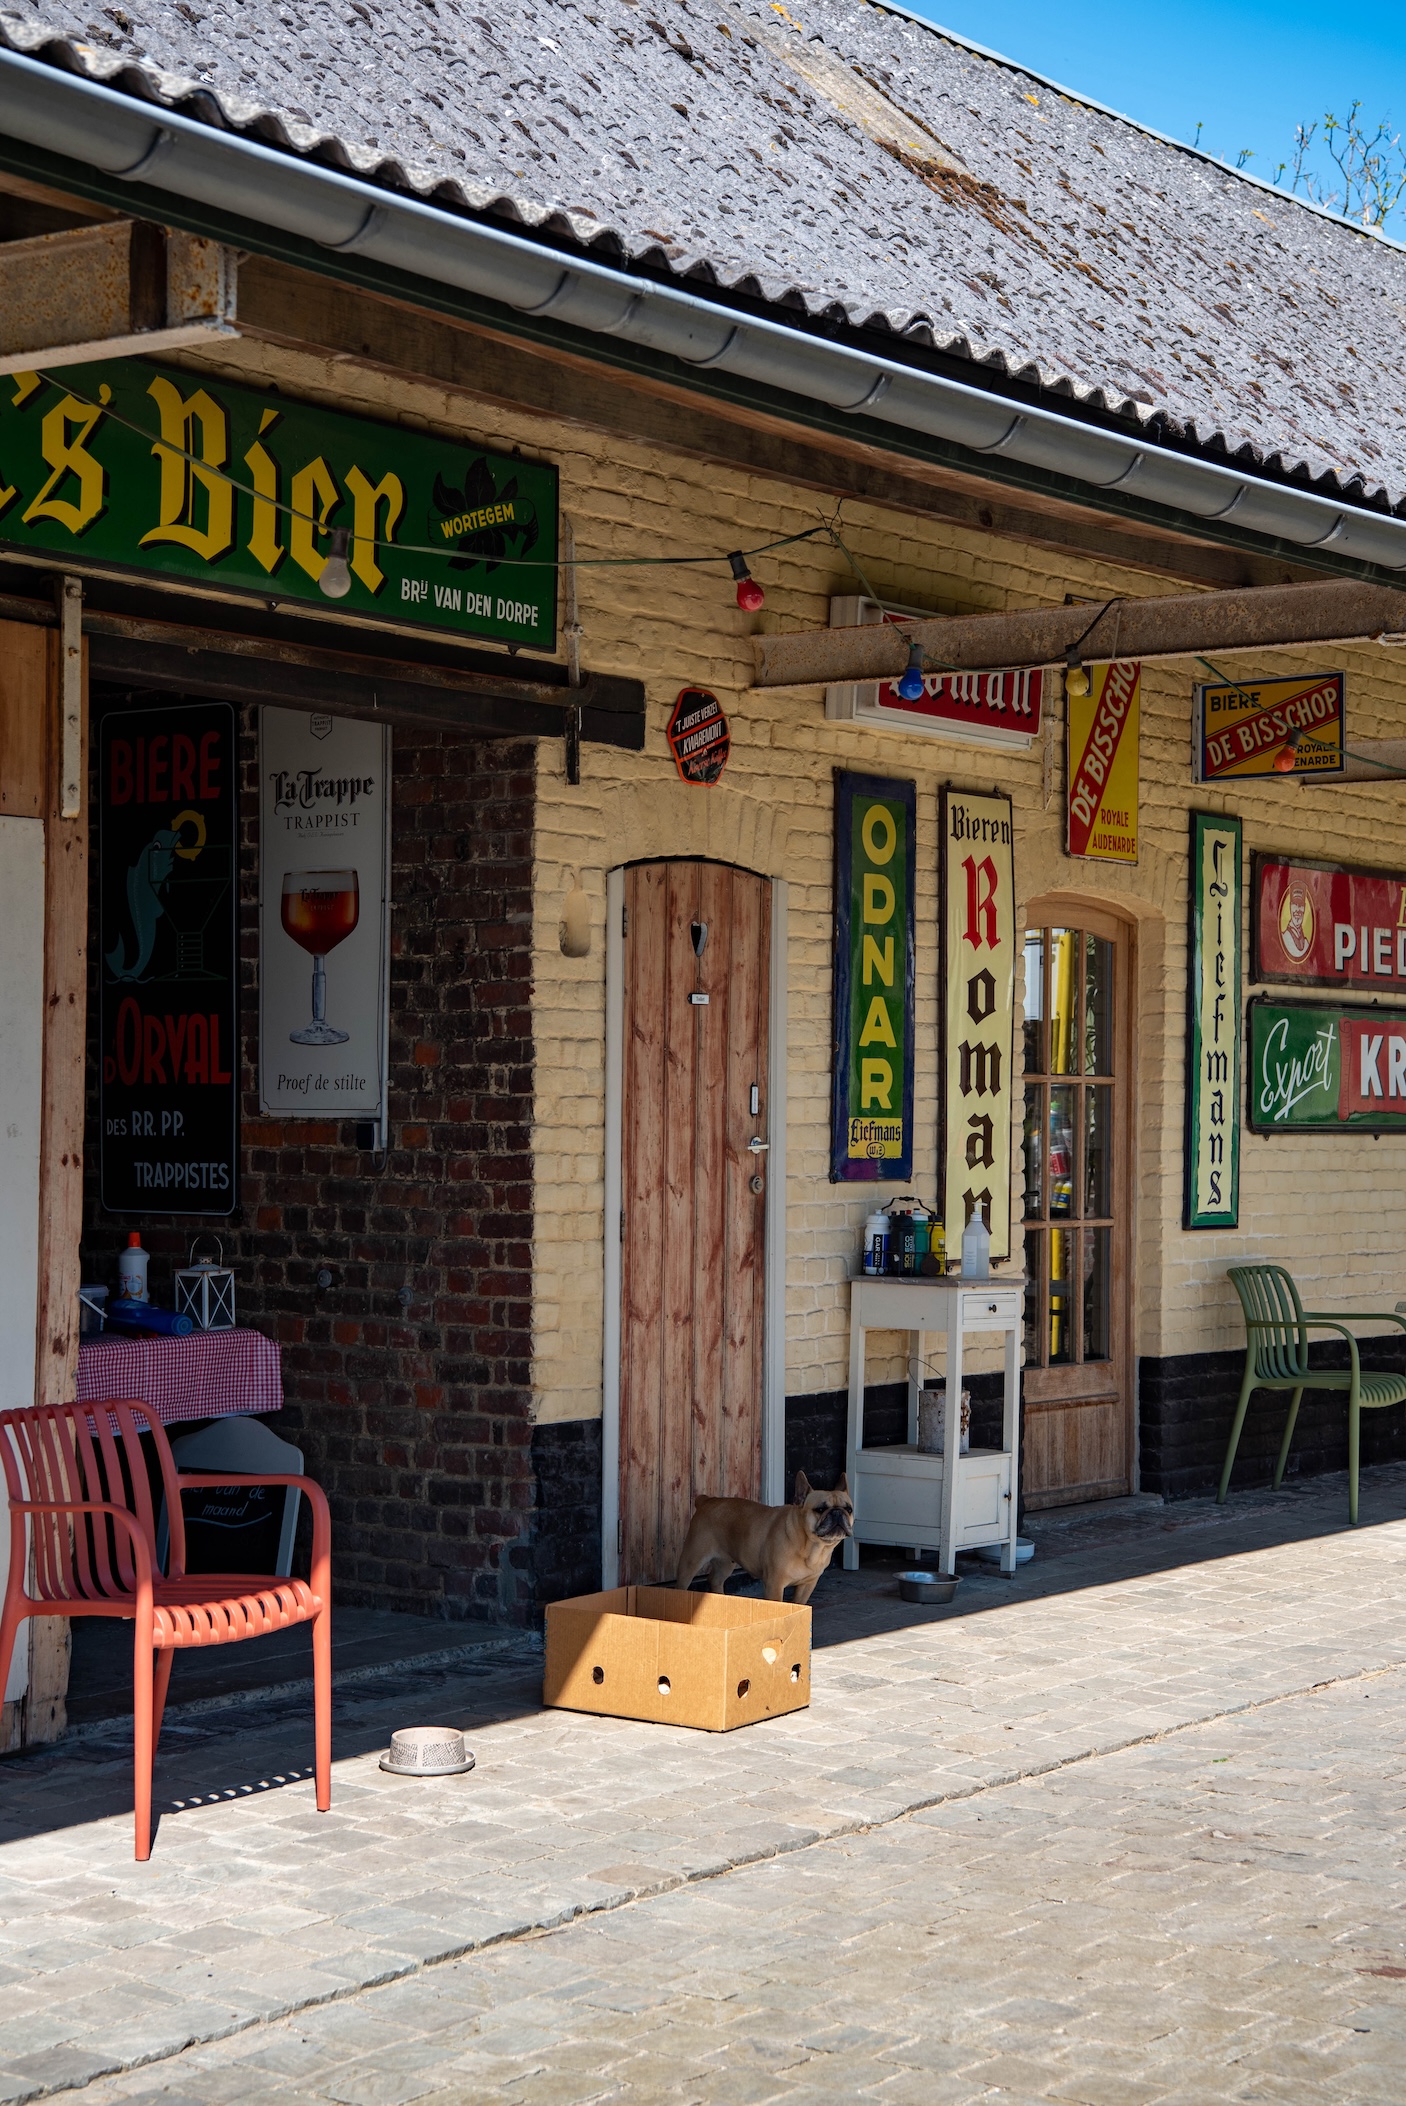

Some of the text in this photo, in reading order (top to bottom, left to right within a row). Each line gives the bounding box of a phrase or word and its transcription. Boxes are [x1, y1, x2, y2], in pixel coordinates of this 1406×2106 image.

[138, 375, 404, 595] Bier
[440, 501, 515, 538] WORTEGEM
[434, 584, 461, 612] VAN
[466, 591, 492, 618] DEN
[496, 597, 539, 627] DORPE
[682, 720, 722, 755] KWAREMONT
[1206, 686, 1338, 768] DE BISSCHOP
[1071, 661, 1138, 827] DE BISSCHO
[1297, 742, 1336, 753] ROYALE
[110, 731, 222, 806] BIERE
[1271, 755, 1336, 769] ENARDE
[269, 767, 375, 815] La Trappe
[283, 813, 361, 830] TRAPPIST
[950, 805, 1011, 846] Bieren
[1101, 808, 1129, 828] ROYALE
[1092, 830, 1136, 854] AUDENARDE
[277, 1073, 366, 1094] Proef de stilte
[1260, 1018, 1337, 1120] Export
[106, 1110, 185, 1137] DES RR. PP.
[850, 1118, 900, 1147] Liefmans
[133, 1162, 229, 1190] TRAPPISTES
[201, 1501, 249, 1517] maand
